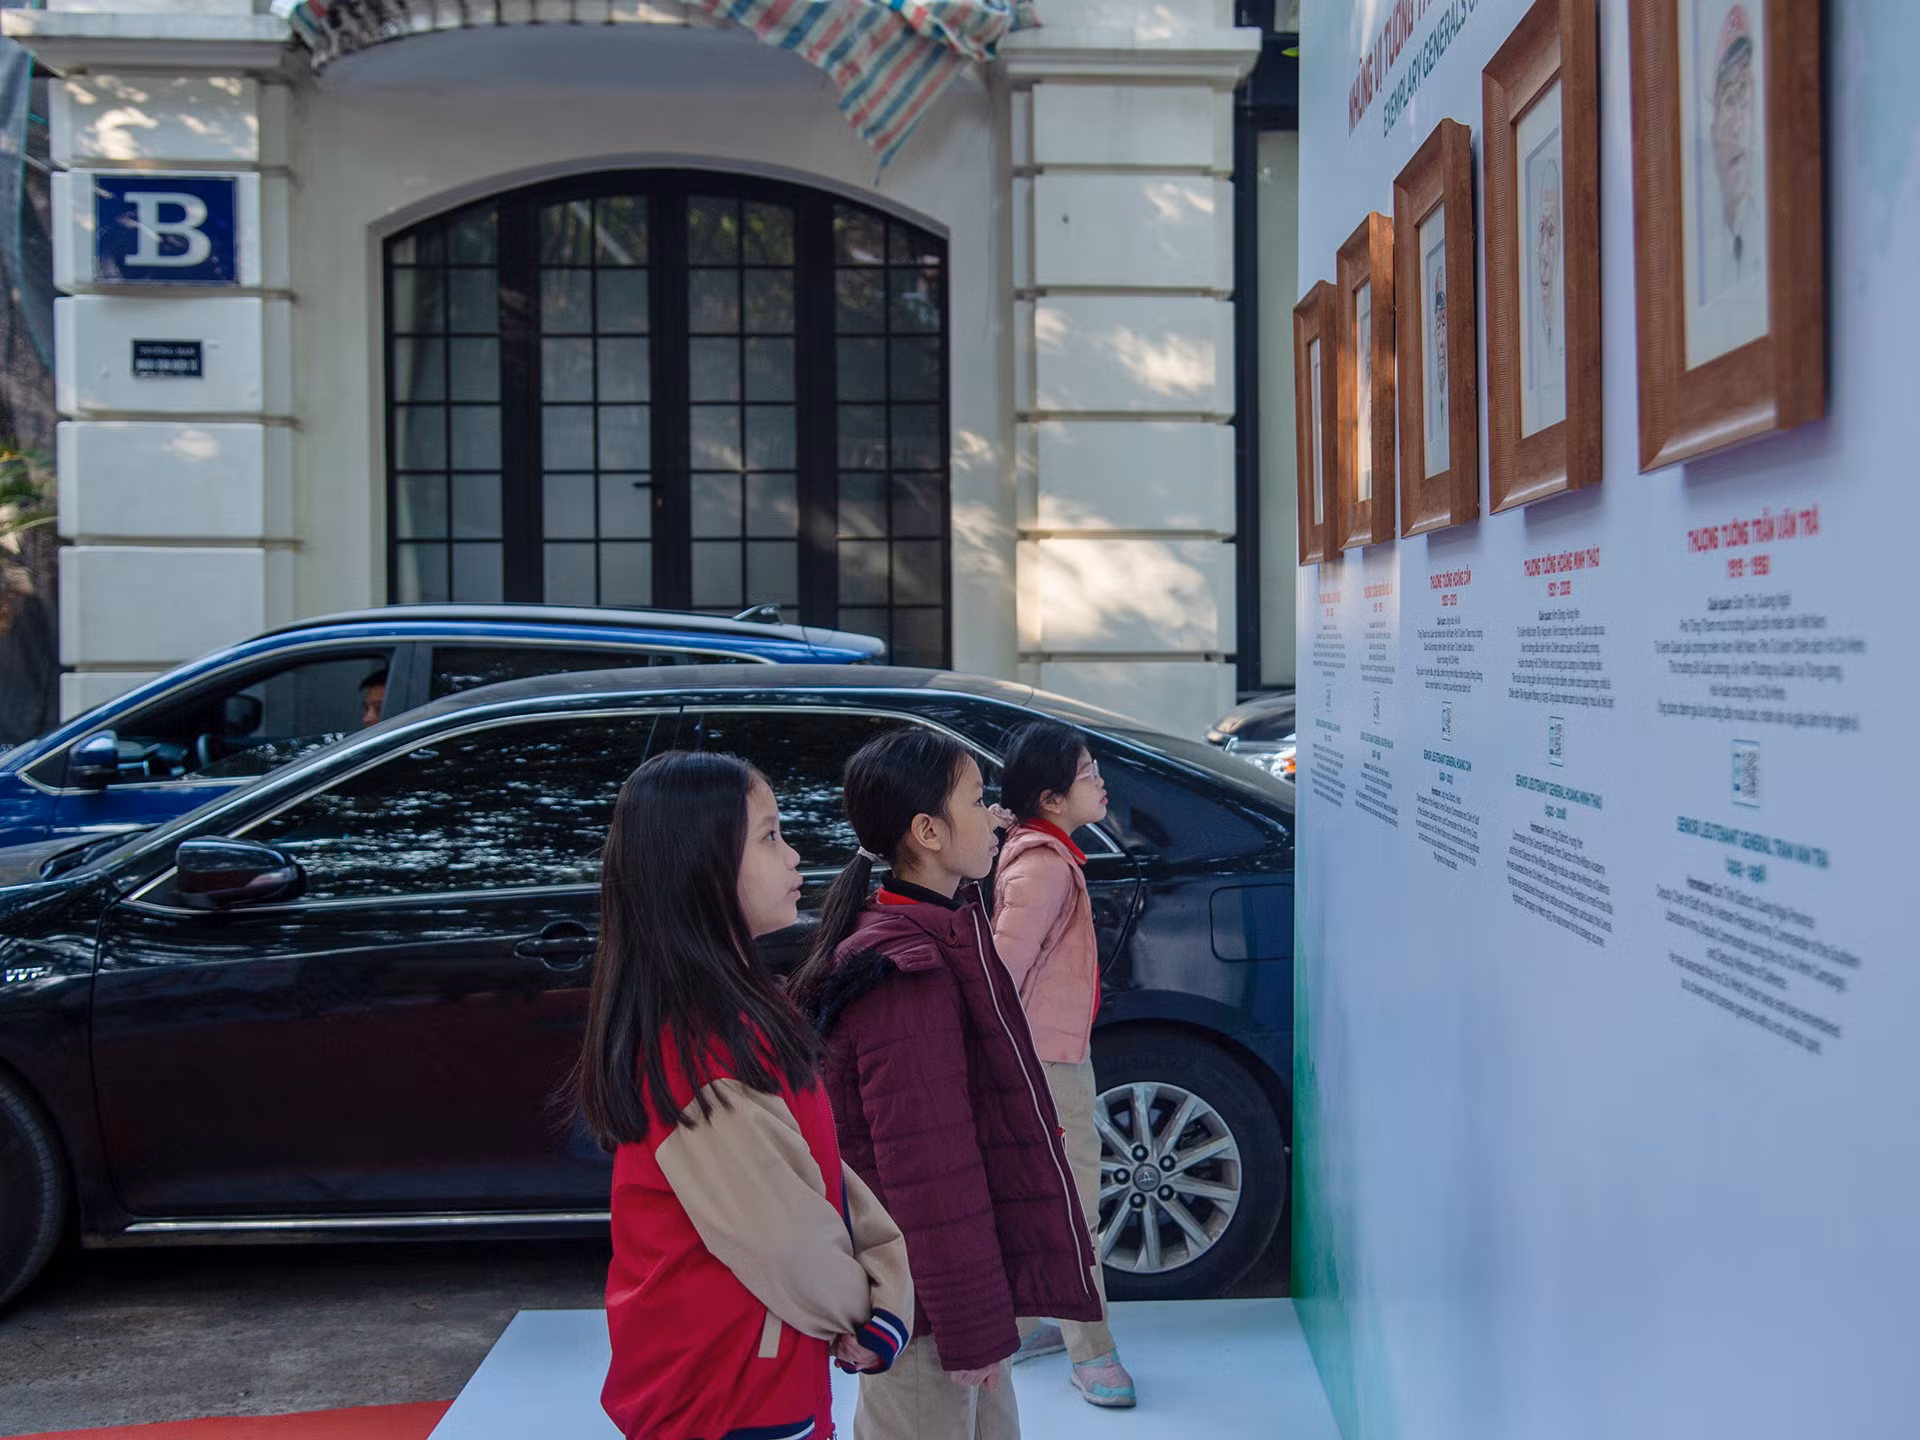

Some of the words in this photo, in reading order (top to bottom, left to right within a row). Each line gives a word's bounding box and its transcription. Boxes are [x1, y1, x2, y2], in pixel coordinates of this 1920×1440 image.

[1384, 48, 1421, 138] EXEMPLARY
[1423, 0, 1466, 78] GENERALS
[123, 191, 212, 267] B
